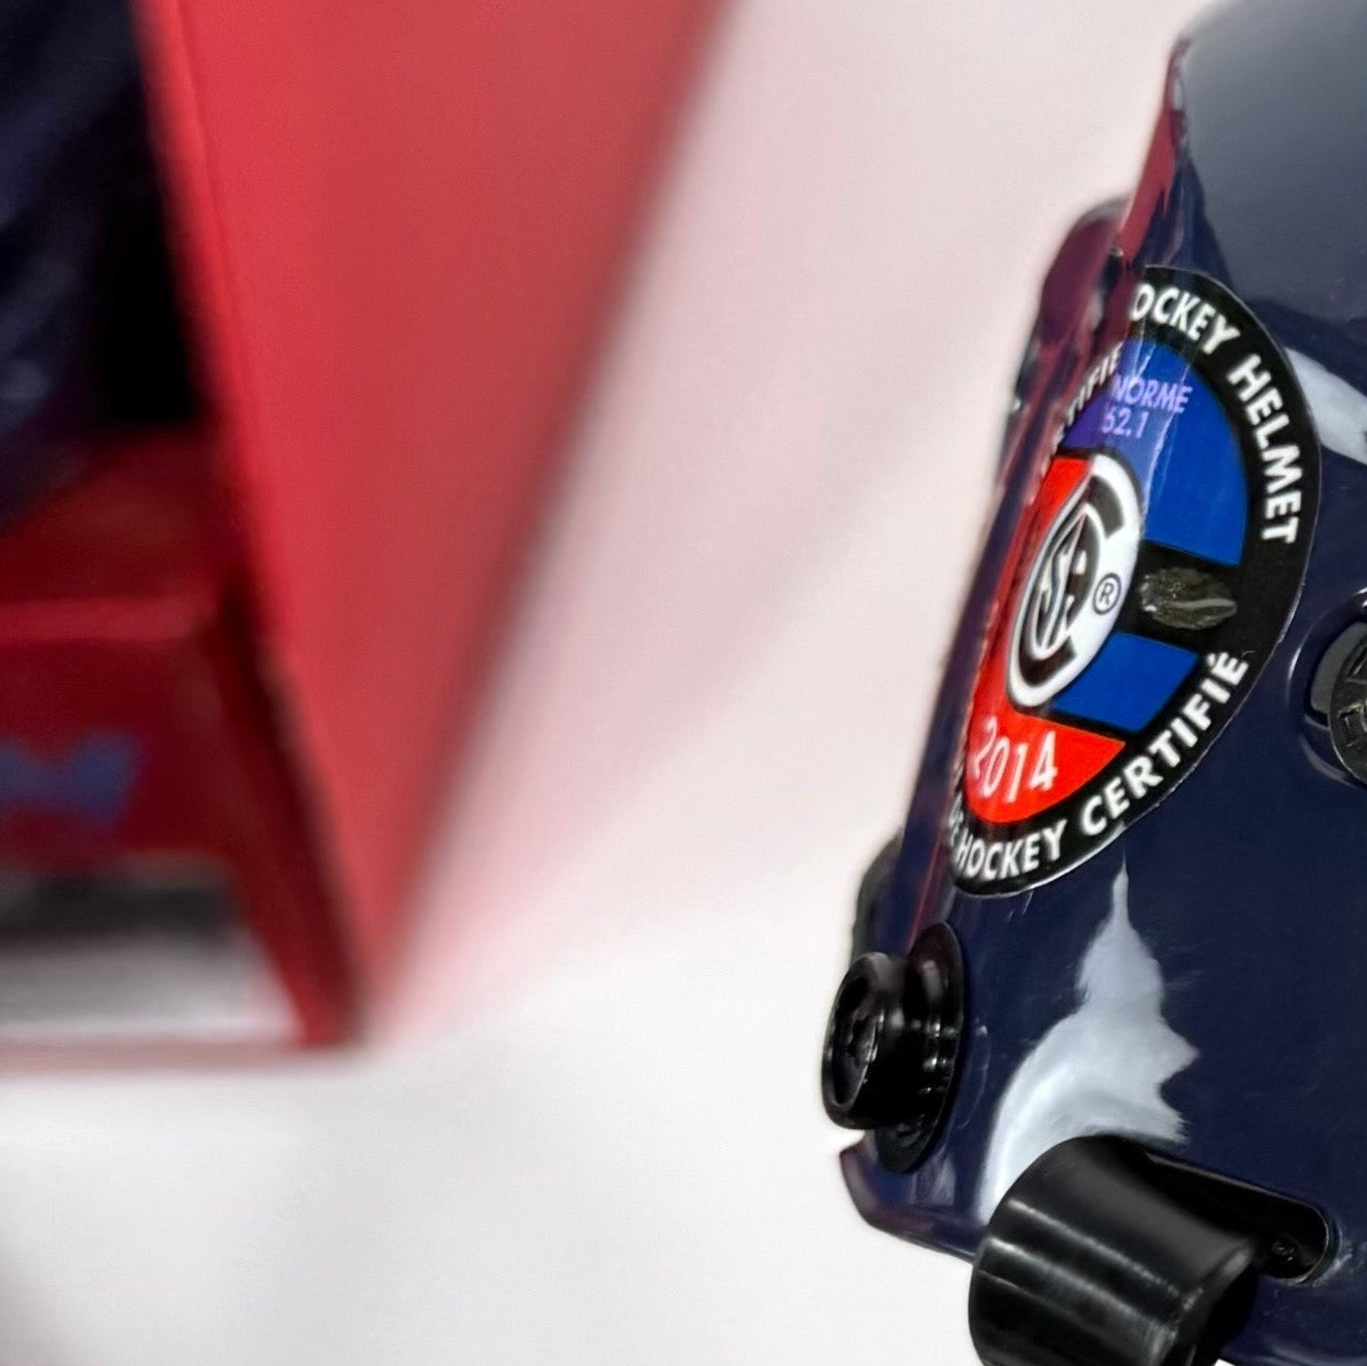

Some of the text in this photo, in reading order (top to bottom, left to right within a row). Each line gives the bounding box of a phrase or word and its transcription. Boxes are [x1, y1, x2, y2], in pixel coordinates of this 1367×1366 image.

[1111, 374, 1193, 414] NORME
[1129, 283, 1303, 545] OCKEY HELMET
[954, 819, 1068, 881] HOCKEY
[1080, 652, 1249, 836] CERTIFIÉ
[971, 715, 1058, 805] 2014
